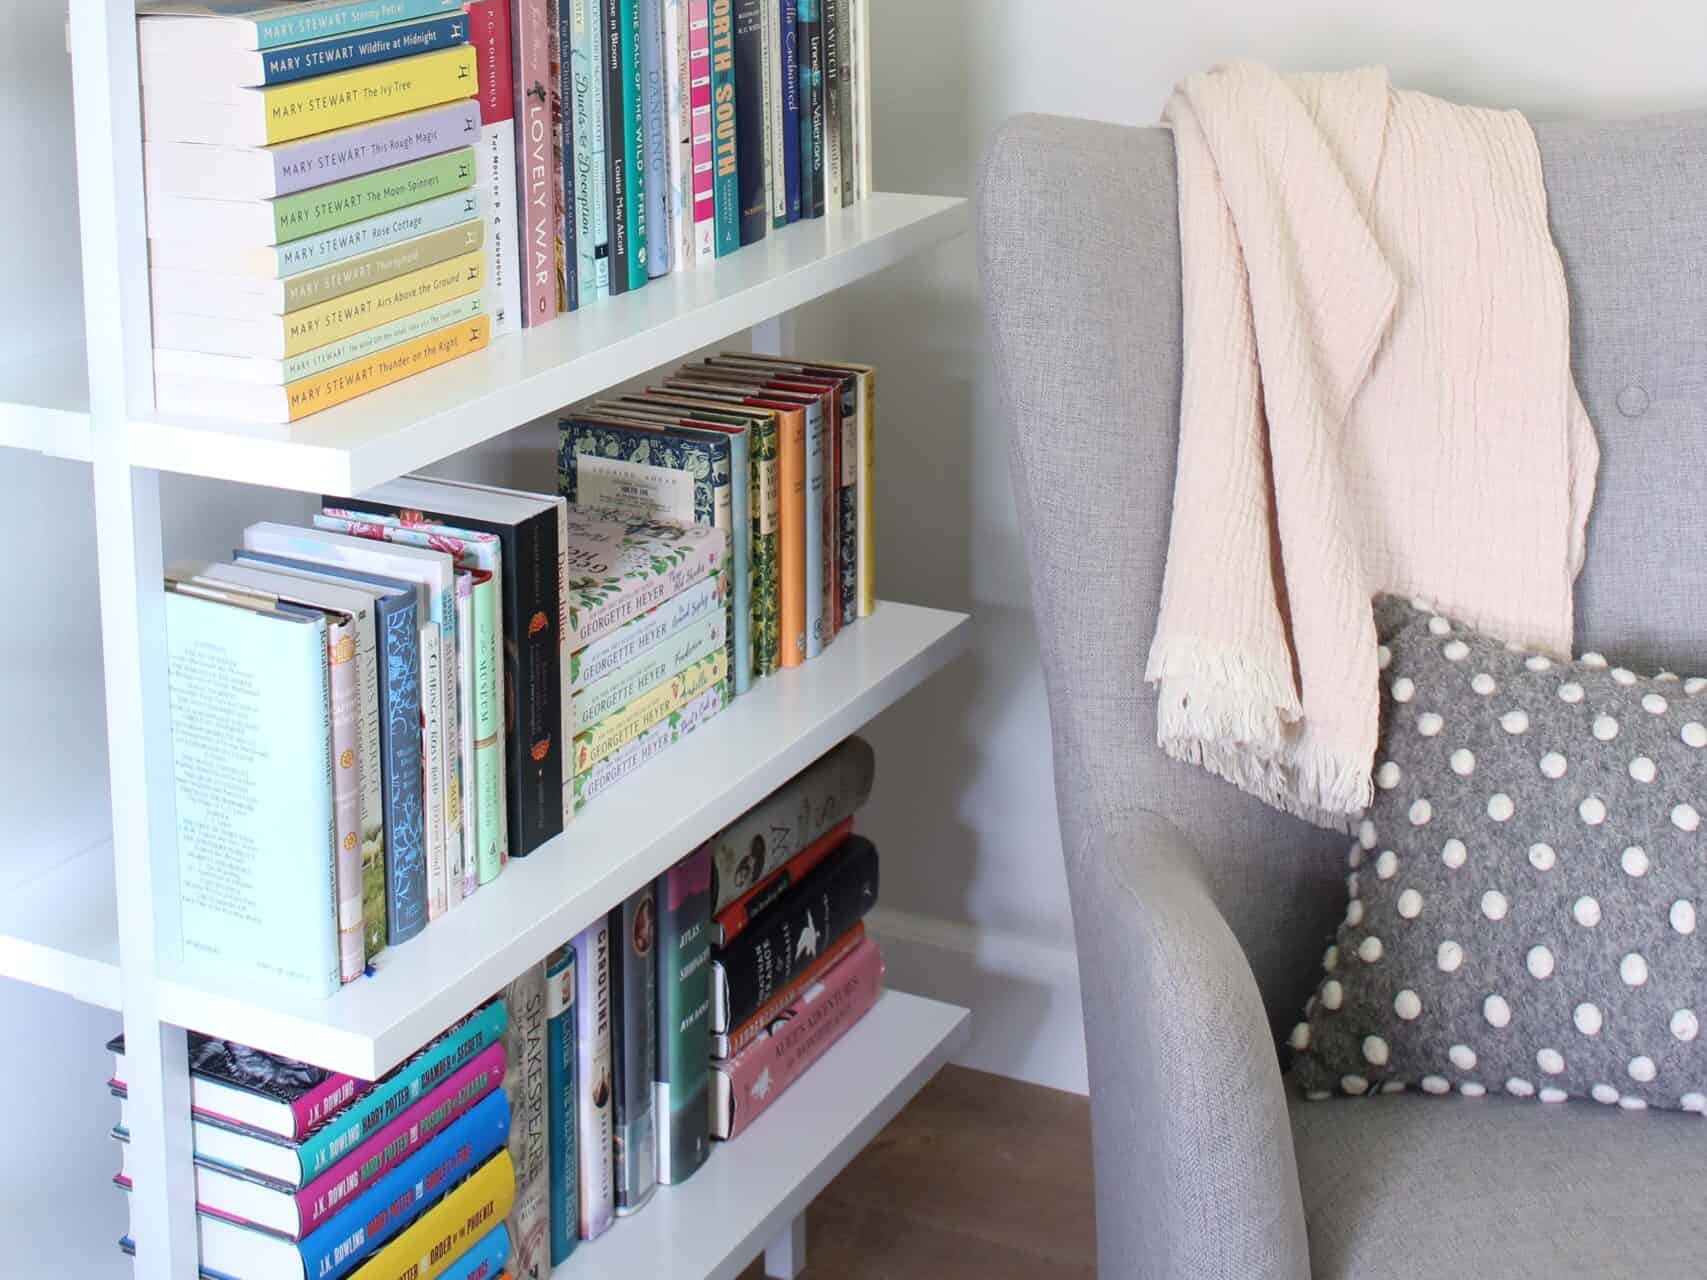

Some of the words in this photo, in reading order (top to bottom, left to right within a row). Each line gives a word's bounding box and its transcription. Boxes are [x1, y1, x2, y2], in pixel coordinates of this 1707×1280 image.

[263, 25, 295, 40] MARY
[299, 12, 347, 33] STEWART
[269, 55, 301, 73] MARY
[305, 46, 353, 67] STEWART
[358, 37, 391, 56] Wildfire
[393, 38, 401, 48] at
[403, 30, 437, 46] Midnight
[610, 20, 616, 30] in
[610, 33, 619, 70] Bloom
[272, 100, 303, 119] MARY
[309, 90, 358, 112] STEWART
[363, 87, 378, 98] The
[380, 84, 393, 97] Ivy
[395, 81, 411, 92] Tree
[576, 72, 589, 124] Duels
[635, 74, 640, 84] OF
[786, 32, 801, 111] Enchanted
[282, 160, 313, 177] MARY
[318, 147, 366, 169] STEWART
[371, 141, 388, 154] This
[390, 135, 414, 151] Rough
[416, 131, 438, 145] Magic
[531, 107, 546, 208] LOVELY
[634, 128, 644, 171] WILD
[715, 83, 736, 176] SOUTH
[813, 105, 824, 171] Valerians
[280, 208, 309, 226] MARY
[315, 195, 362, 217] STEWART
[367, 190, 382, 201] The
[578, 153, 591, 235] Deception
[616, 197, 624, 220] May
[638, 192, 646, 236] FREE
[284, 247, 314, 264] MARY
[319, 231, 367, 255] STEWART
[372, 226, 390, 238] Rose
[392, 217, 422, 233] Cottage
[535, 218, 548, 287] WAR
[616, 223, 625, 255] Alcott
[289, 282, 318, 299] MARY
[324, 265, 371, 289] STEWART
[290, 316, 325, 336] MARY
[325, 302, 372, 327] STEWART
[377, 297, 392, 307] Airs
[394, 290, 417, 304] Above
[418, 282, 431, 293] the
[433, 272, 460, 289] Ground
[290, 359, 309, 373] MARY
[312, 348, 346, 365] STEWART
[291, 387, 321, 407] MARY
[326, 369, 373, 394] STEWART
[379, 355, 410, 374] Thunder
[412, 352, 421, 362] on
[423, 344, 437, 356] the
[438, 336, 459, 353] Right
[580, 600, 633, 640] GEORGETTE
[636, 583, 665, 609] HEYER
[365, 645, 376, 704] JAMES
[583, 639, 635, 682] GEORGETTE
[638, 624, 667, 650] HEYER
[479, 658, 489, 722] MUSEUM
[582, 681, 634, 722] GEORGETTE
[638, 663, 667, 689] HEYER
[368, 710, 380, 793] HERRIOT
[590, 719, 640, 761] GEORGETTE
[643, 699, 671, 725] HEYER
[587, 753, 638, 796] GEORGETTE
[641, 733, 669, 760] HEYER
[679, 925, 700, 949] ATLAS
[597, 929, 609, 1034] CAROLINE
[323, 1079, 355, 1113] ROWLING
[526, 991, 543, 1186] SHAKESPEARE
[329, 1125, 361, 1159] ROWLING
[362, 1104, 384, 1135] HARRY
[384, 1088, 410, 1113] POTTER
[328, 1171, 359, 1209] ROWLING
[384, 1135, 410, 1164] POTTER
[334, 1228, 365, 1269] ROWLING
[390, 1189, 414, 1217] POTTER
[430, 1237, 452, 1266] ORDER
[467, 1201, 495, 1236] PHOENIX
